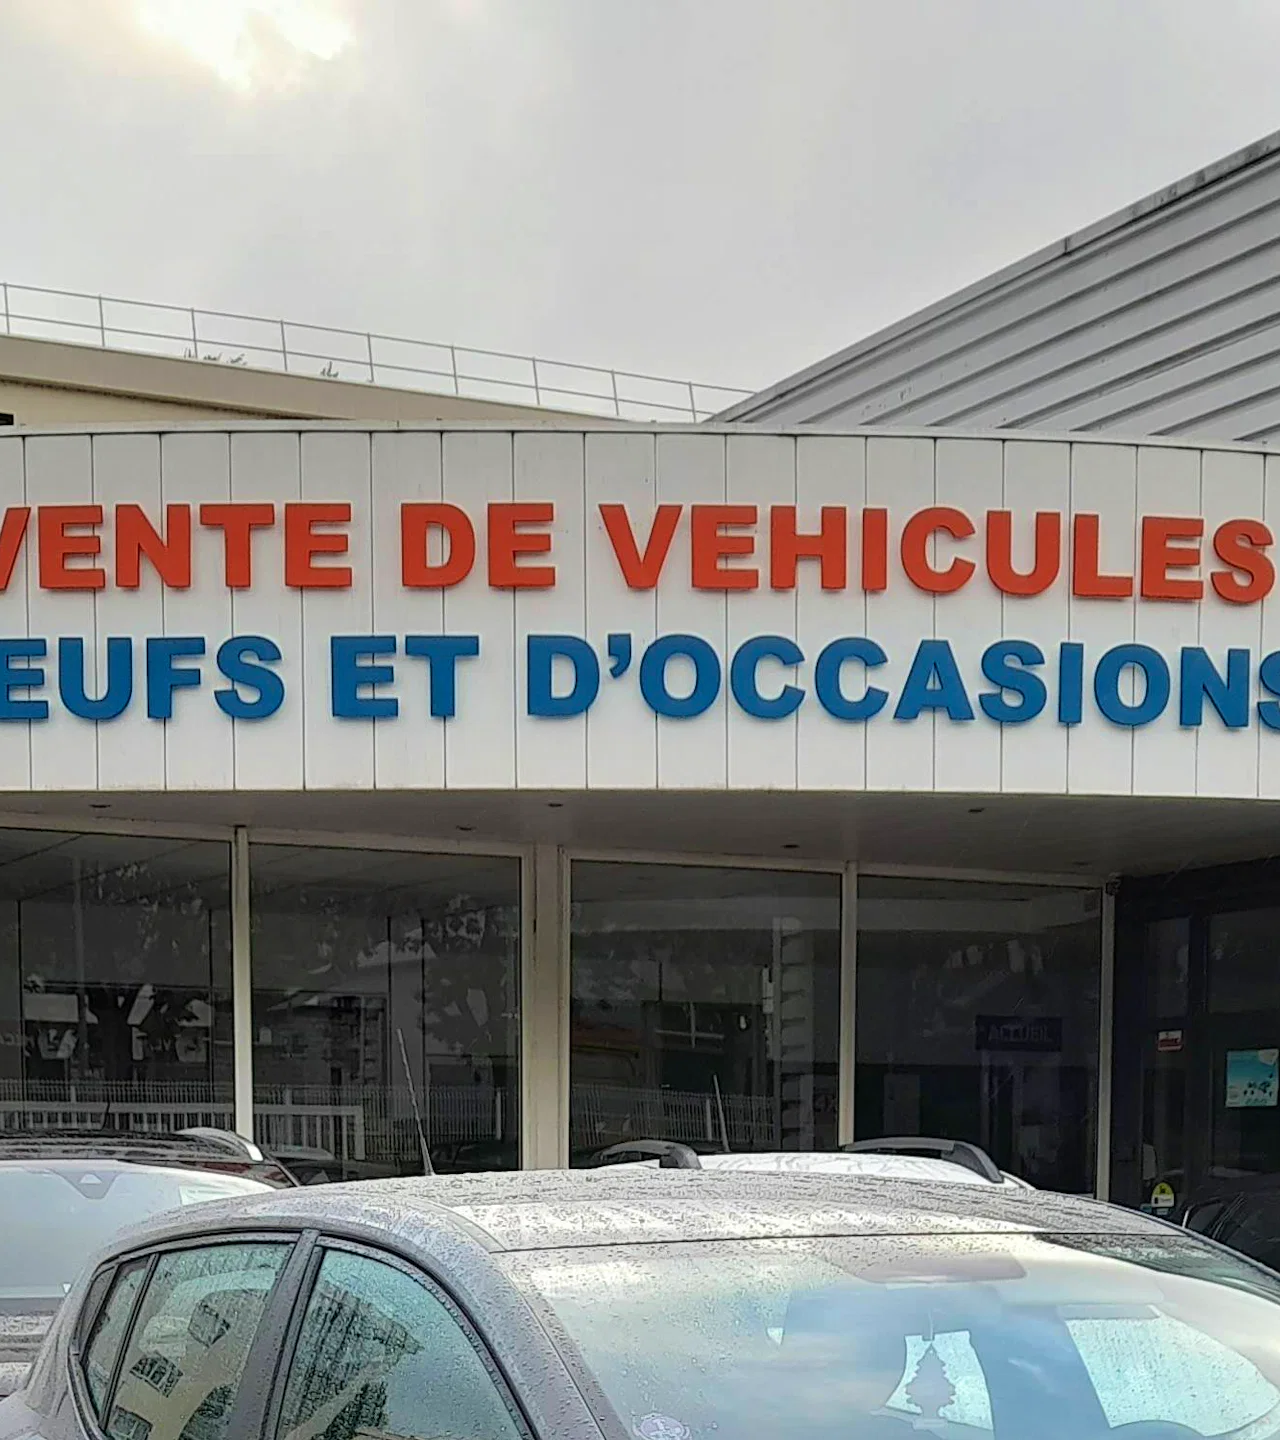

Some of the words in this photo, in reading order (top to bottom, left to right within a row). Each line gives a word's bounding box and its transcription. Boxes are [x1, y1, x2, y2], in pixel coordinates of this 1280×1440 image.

[400, 502, 556, 588] DE
[599, 502, 1276, 604] VEHICULES
[329, 634, 479, 720] ET
